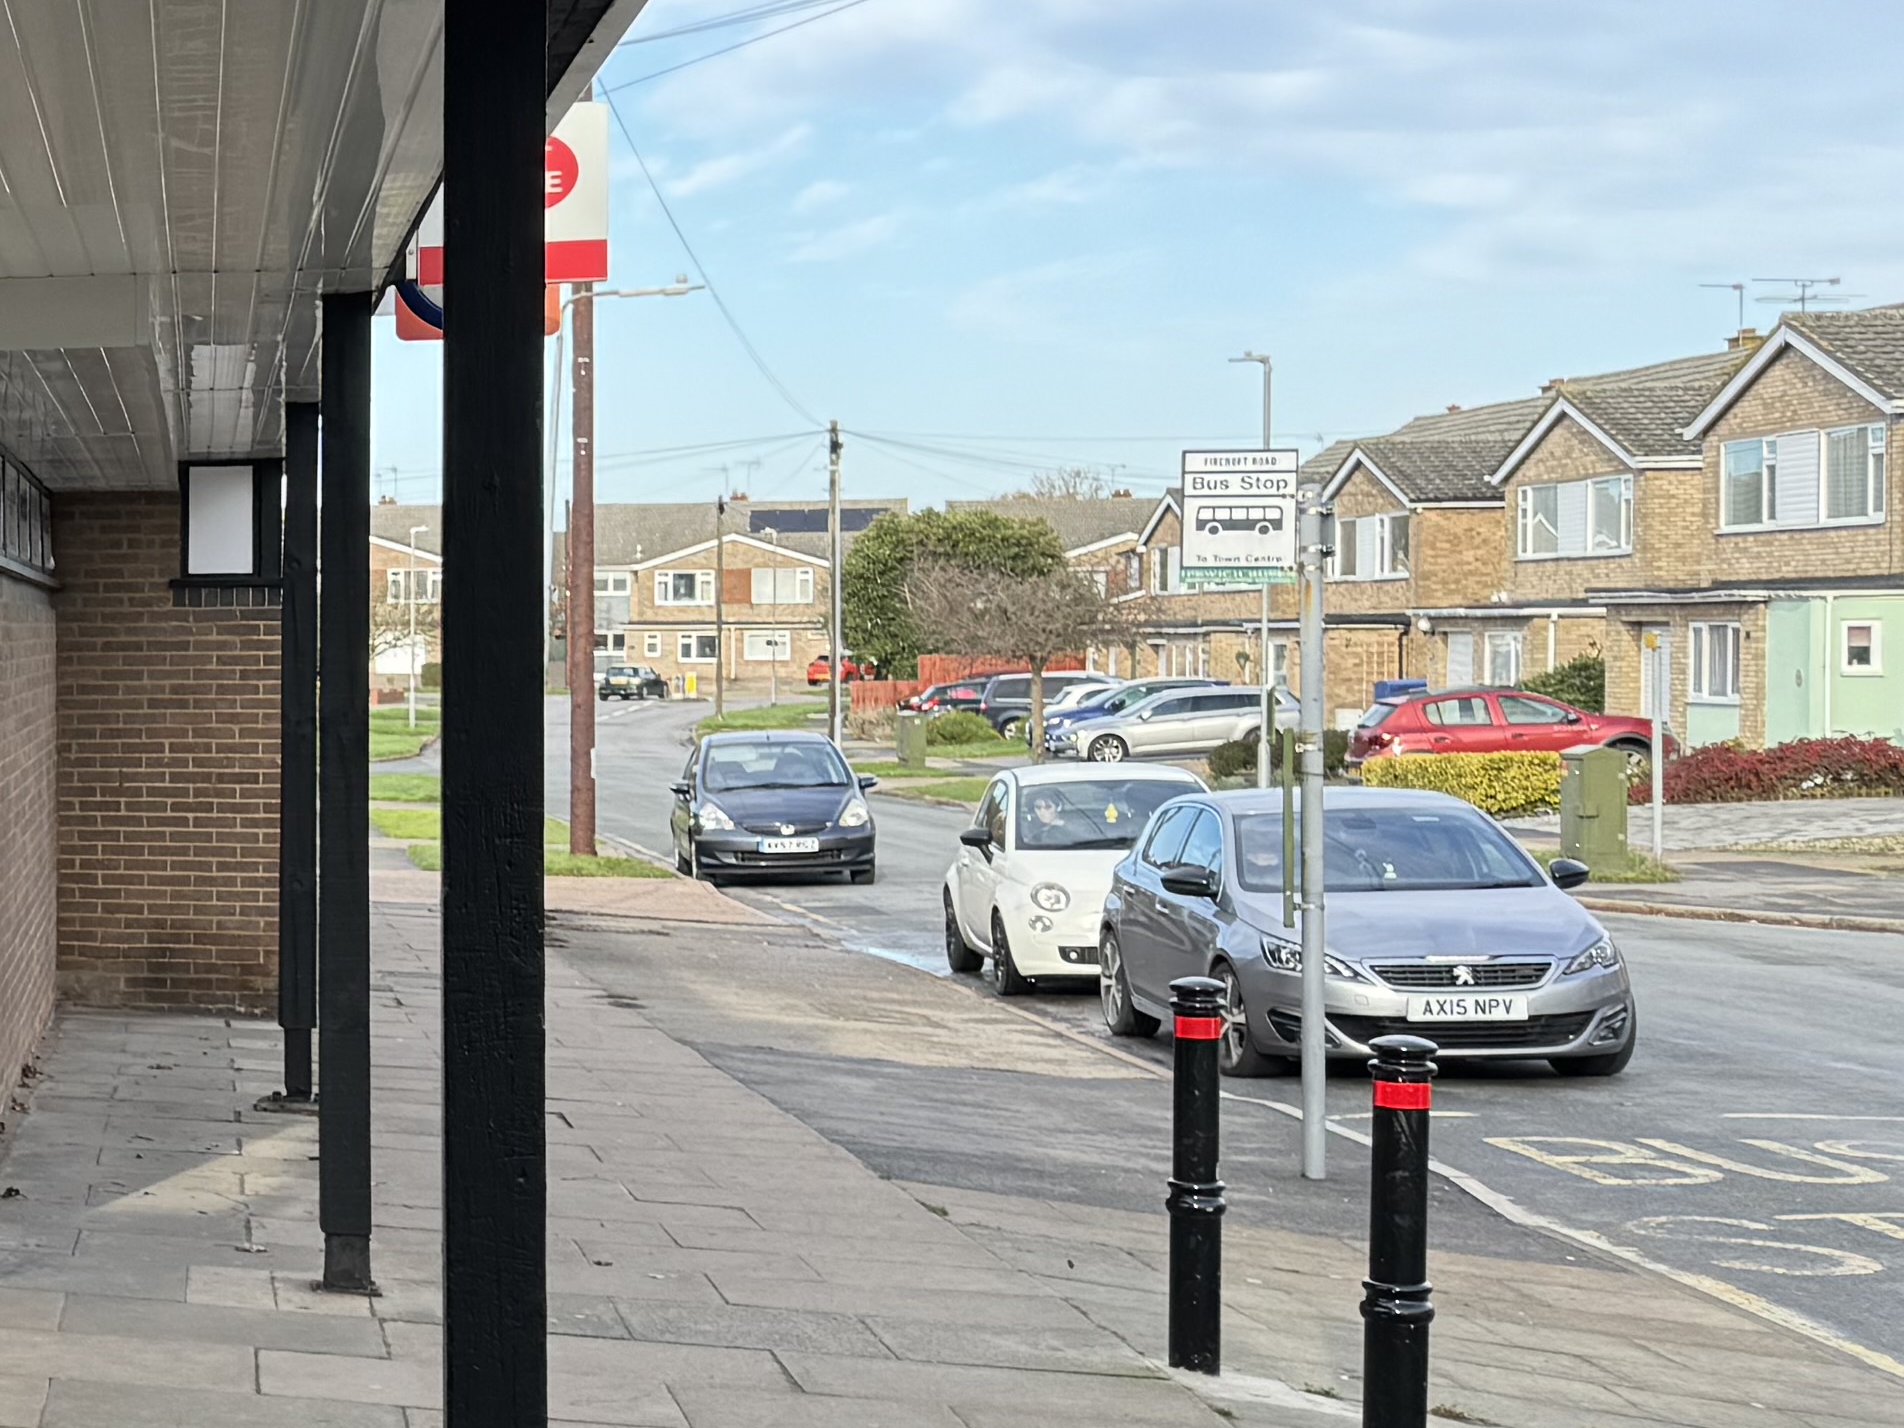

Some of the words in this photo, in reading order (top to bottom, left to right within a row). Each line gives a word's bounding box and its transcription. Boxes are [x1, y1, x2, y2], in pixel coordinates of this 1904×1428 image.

[1252, 456, 1277, 466] ROAD
[1192, 476, 1230, 491] Bus
[1240, 475, 1288, 492] Stop
[1196, 554, 1207, 563] To
[1213, 554, 1240, 563] Town
[1422, 998, 1468, 1016] AX15
[1474, 998, 1513, 1015] NPV
